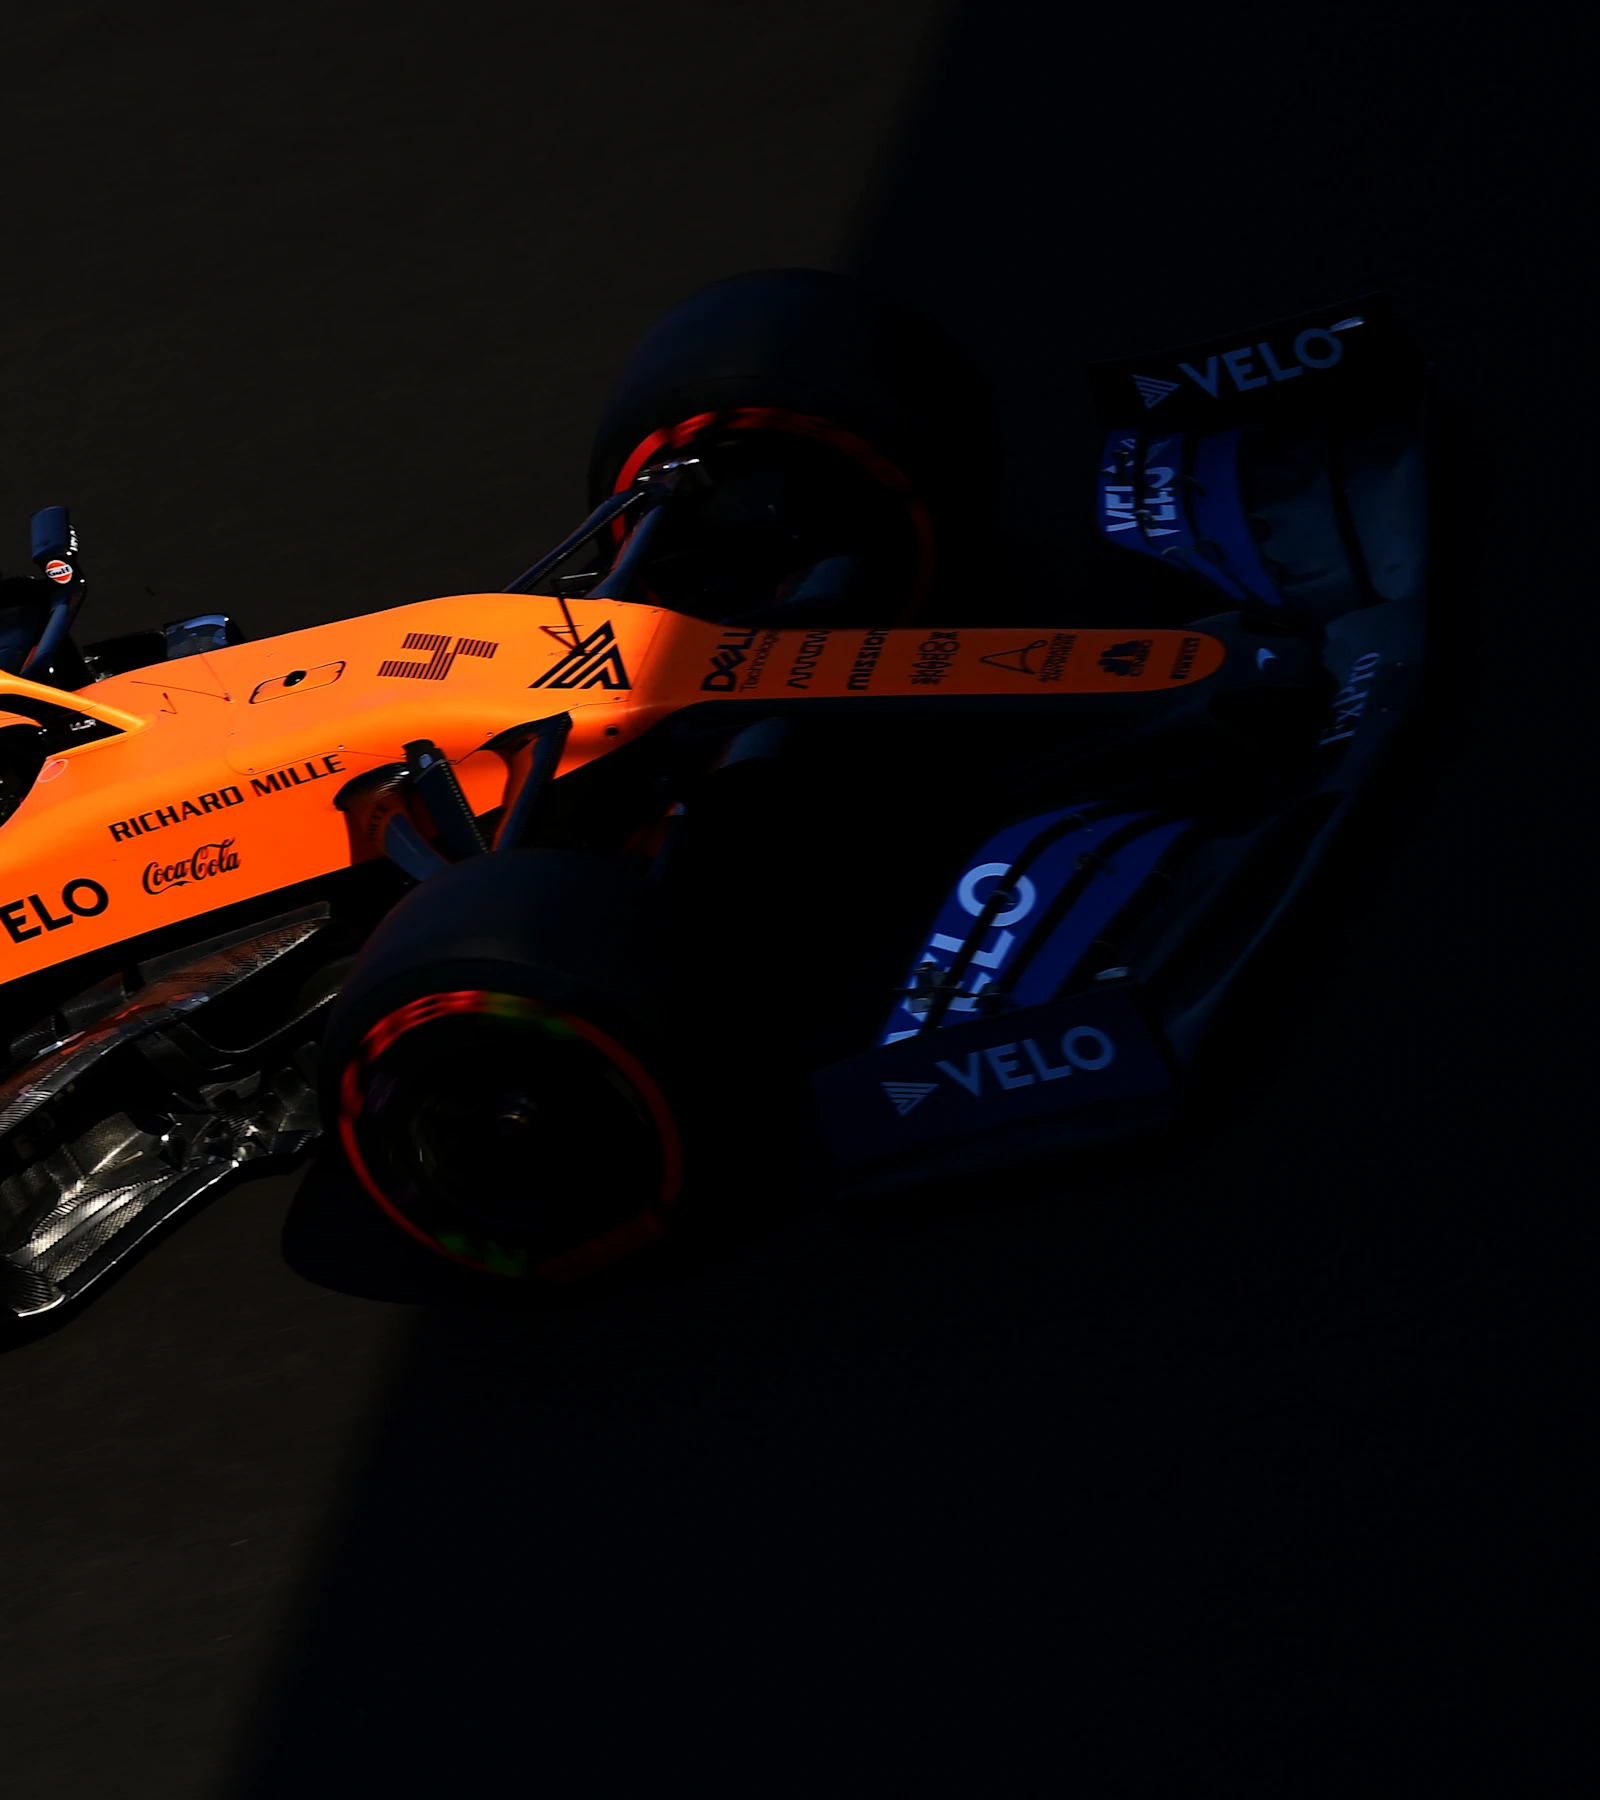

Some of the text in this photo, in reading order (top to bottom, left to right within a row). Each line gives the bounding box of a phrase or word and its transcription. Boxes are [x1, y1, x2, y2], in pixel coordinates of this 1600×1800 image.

[1176, 327, 1345, 400] VELO
[701, 626, 760, 692] DELL
[847, 628, 891, 690] mission
[1315, 652, 1382, 749] FxPro
[108, 753, 346, 843] RICHARD MILLE
[142, 836, 241, 896] Coca-Cola
[932, 1025, 1118, 1098] VELO
